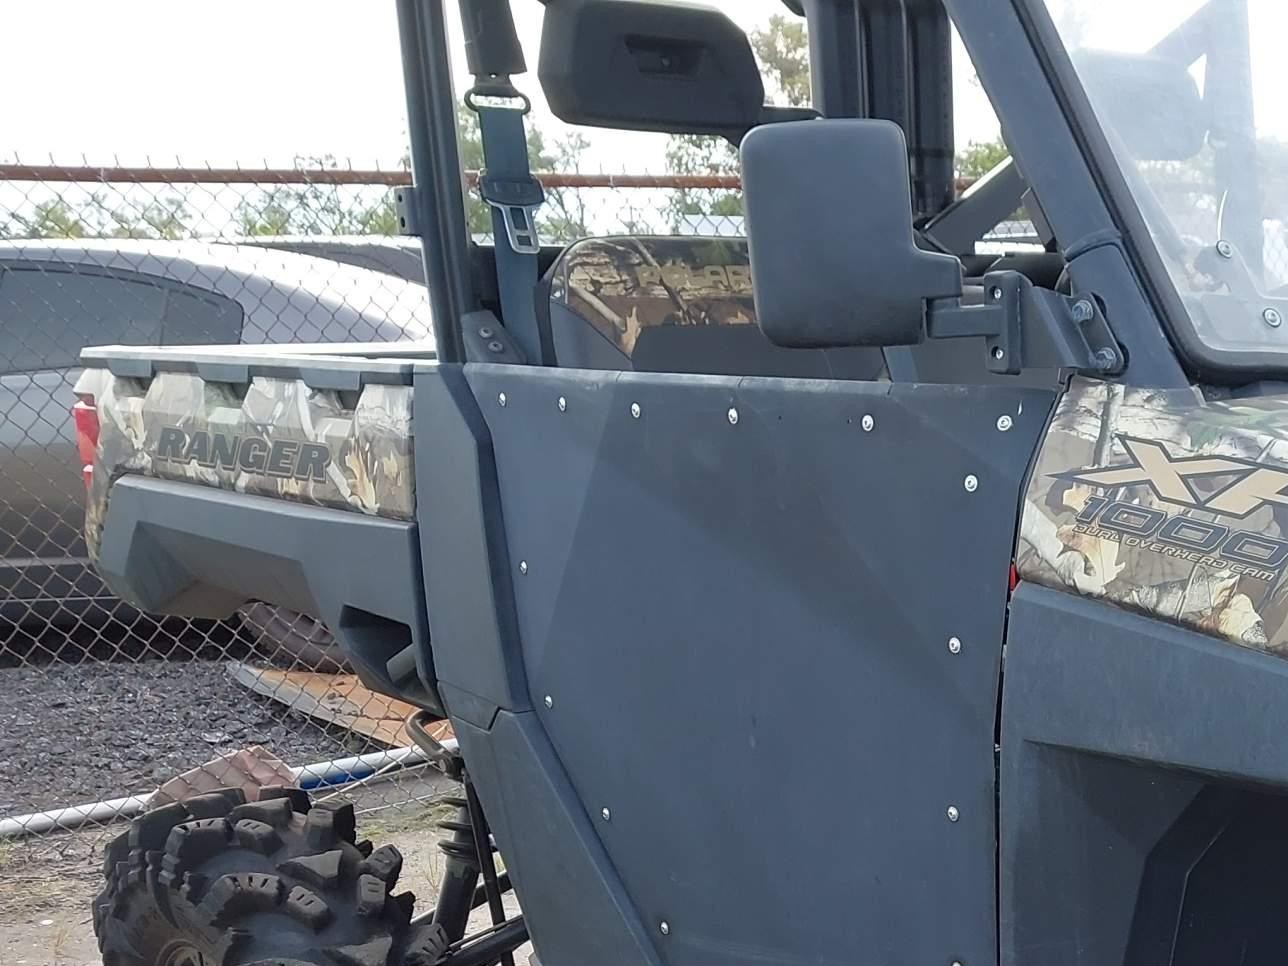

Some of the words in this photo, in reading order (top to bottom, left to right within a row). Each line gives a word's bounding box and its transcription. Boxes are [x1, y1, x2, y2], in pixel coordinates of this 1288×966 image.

[155, 425, 332, 484] RANGER
[1072, 524, 1121, 543] DUAL
[1125, 537, 1229, 570] OVERHEAD
[1229, 564, 1277, 582] CAM
